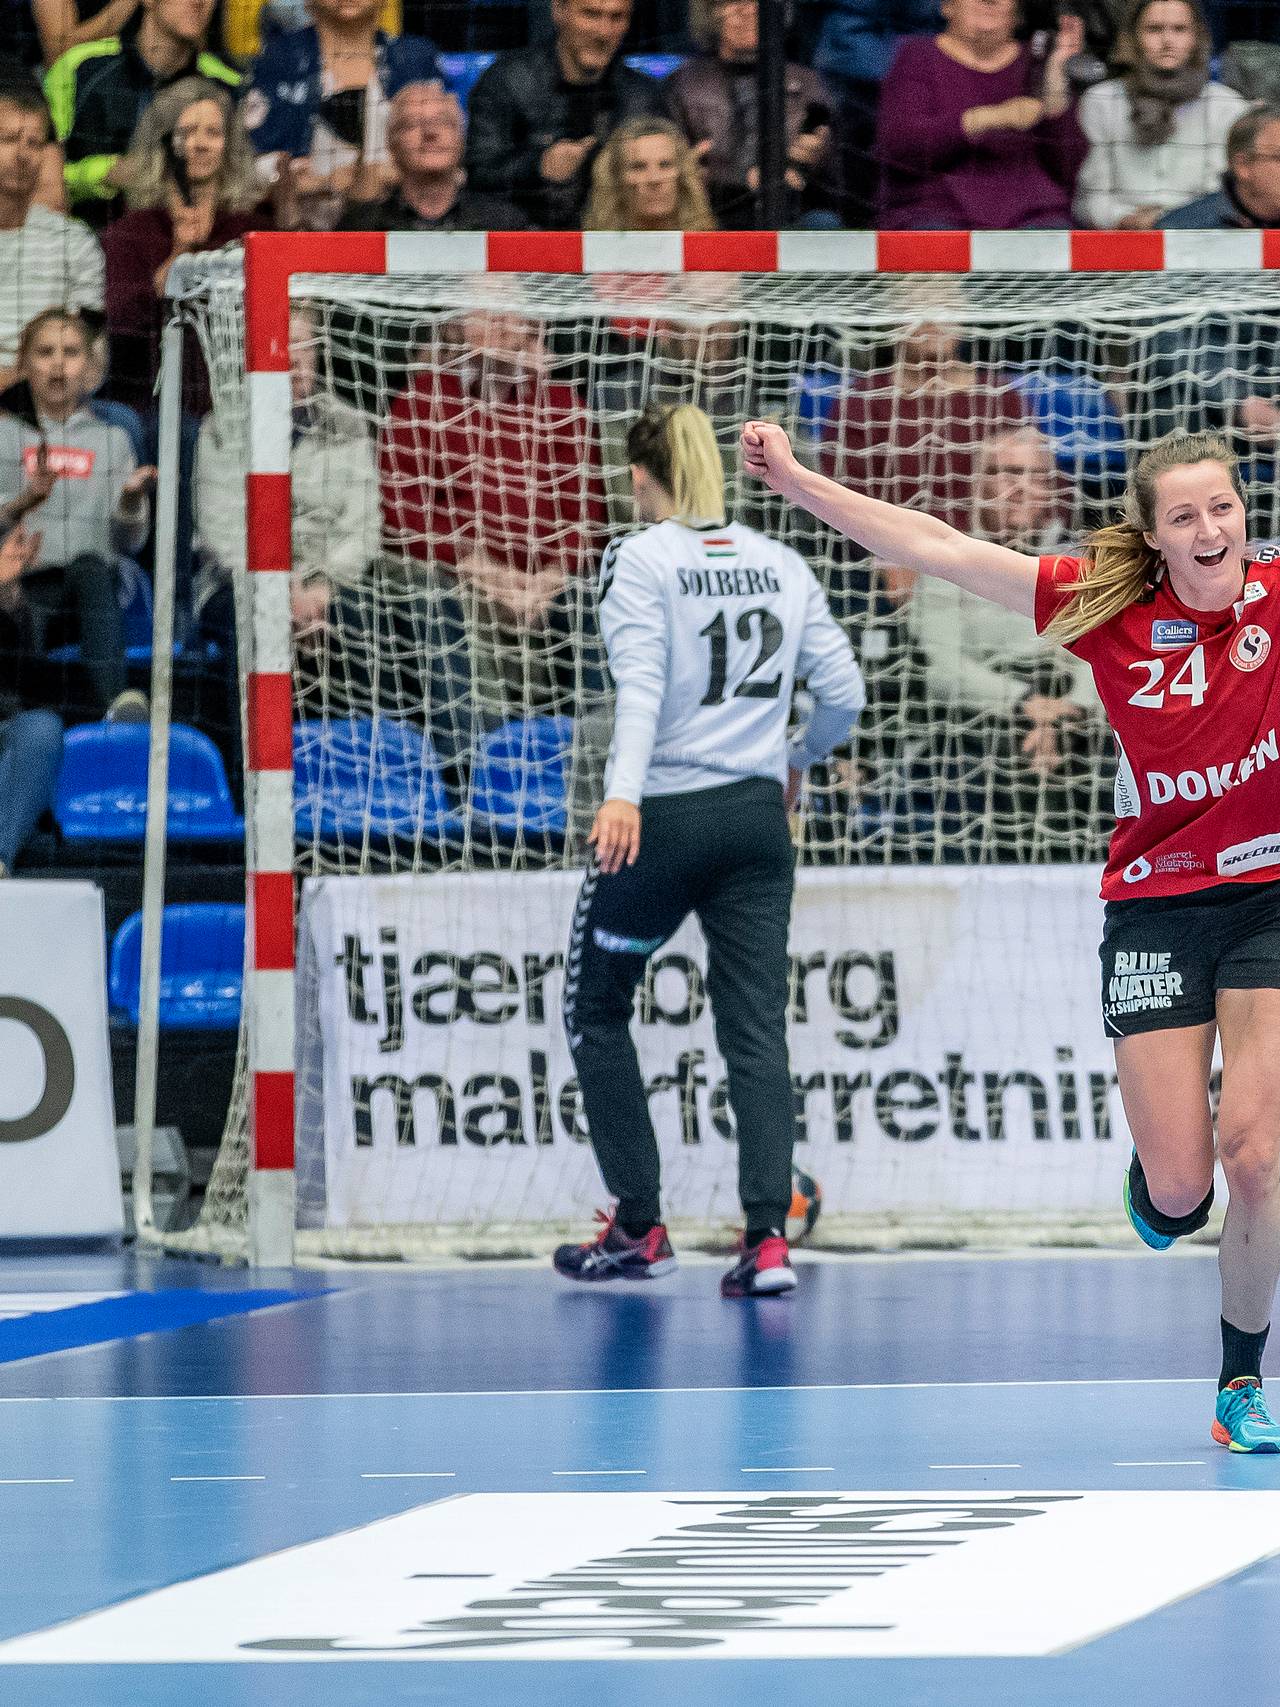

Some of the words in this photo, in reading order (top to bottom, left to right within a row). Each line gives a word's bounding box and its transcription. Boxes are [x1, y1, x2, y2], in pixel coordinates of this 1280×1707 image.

[676, 566, 781, 597] SOLBERG
[1157, 625, 1193, 635] Colliers
[699, 606, 784, 706] 12
[1127, 645, 1209, 709] 24
[1146, 727, 1280, 805] DOKEN
[1109, 971, 1184, 1002] WATER
[1114, 951, 1172, 977] BLUE
[334, 926, 900, 1052] tjærbrg
[1116, 996, 1173, 1015] SHIPPING
[236, 1494, 1085, 1652] Sparinvest
